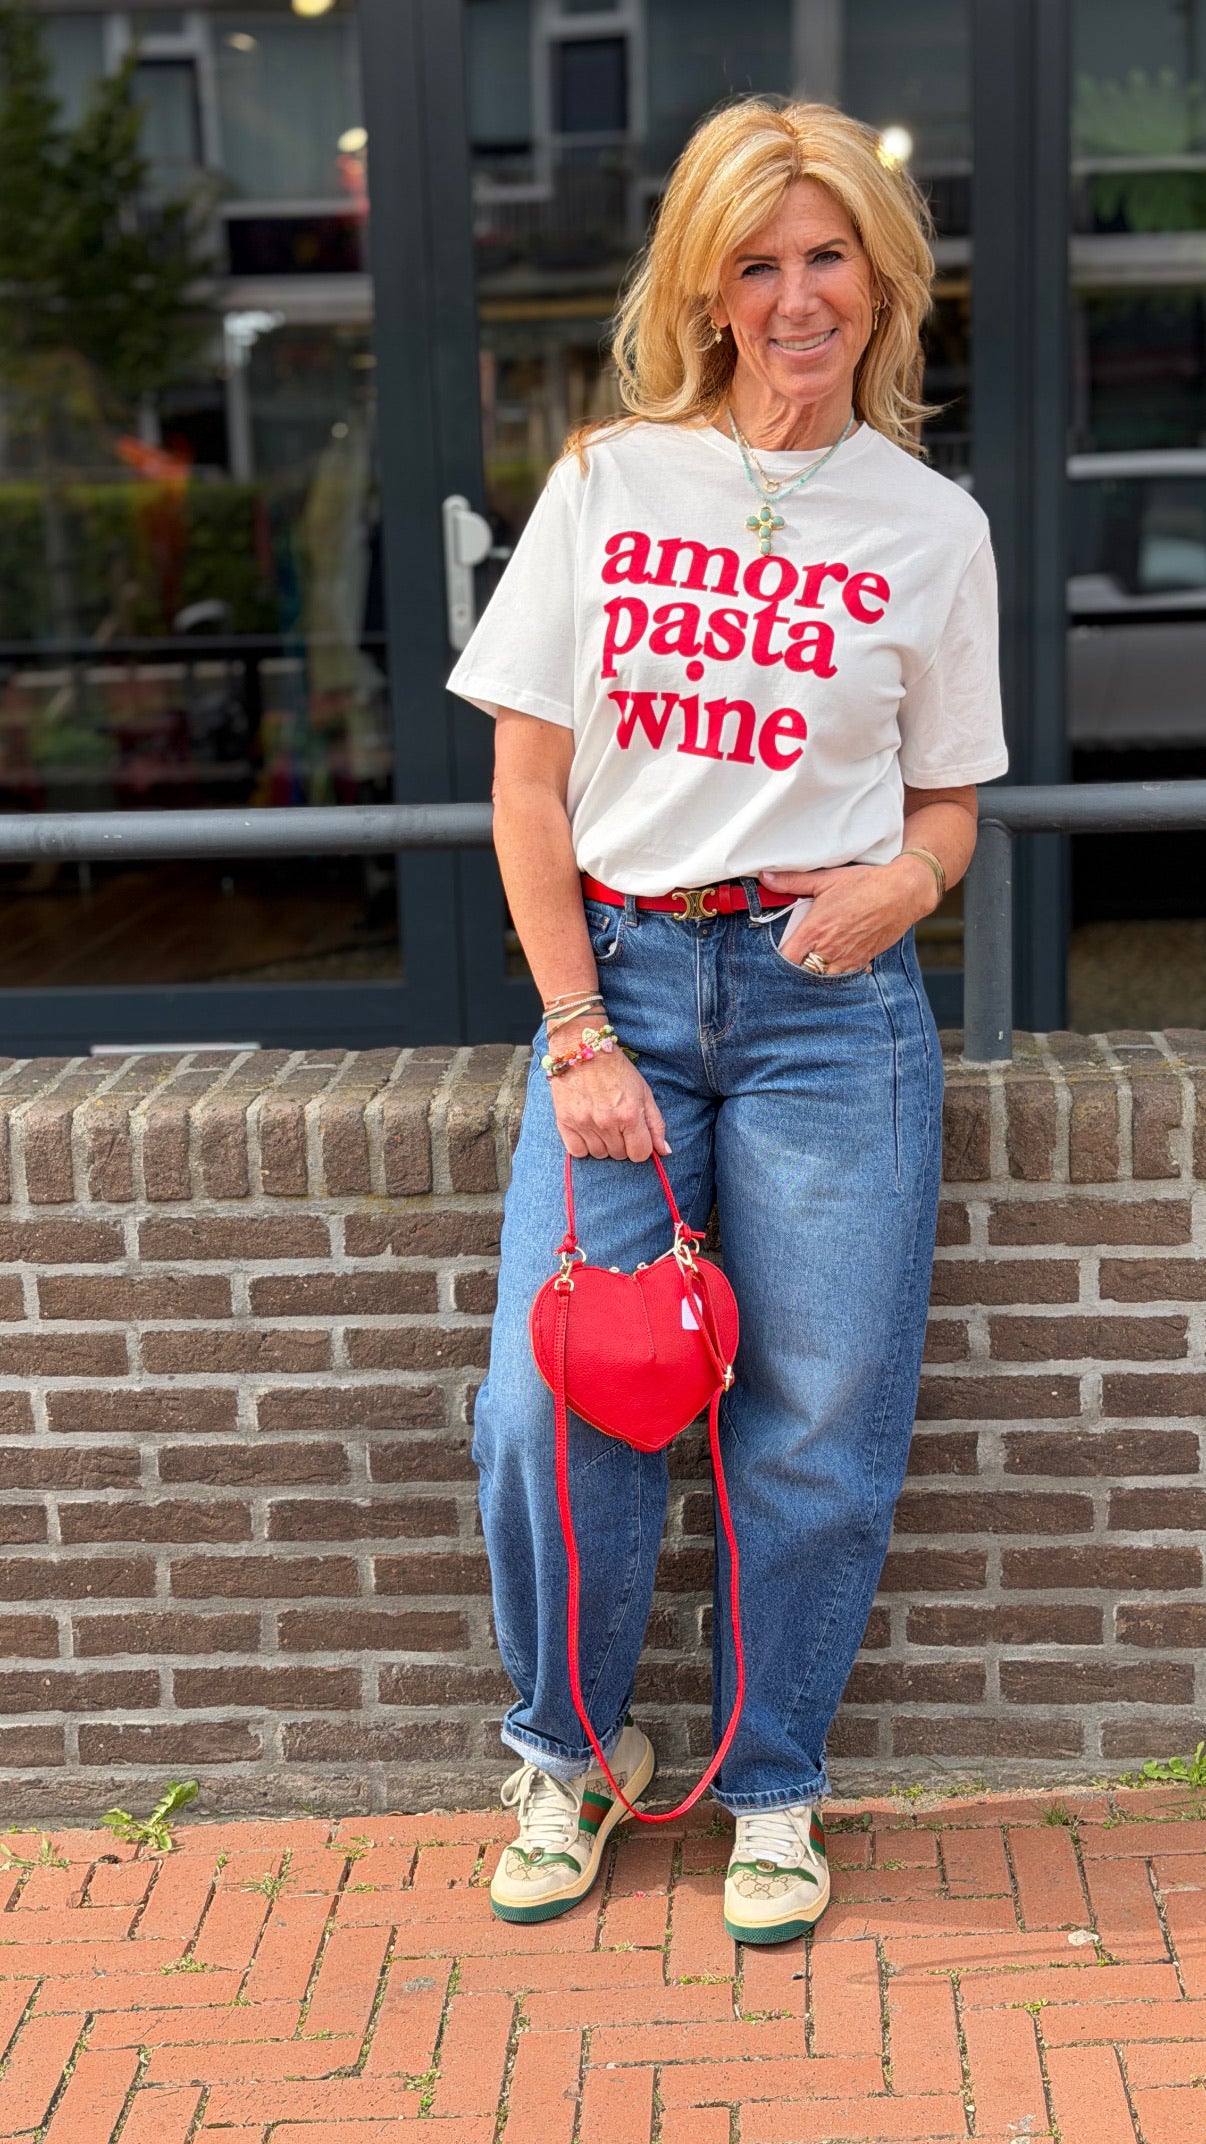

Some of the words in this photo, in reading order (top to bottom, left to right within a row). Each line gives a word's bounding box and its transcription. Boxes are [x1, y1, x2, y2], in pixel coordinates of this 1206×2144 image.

[601, 531, 891, 625] amore
[601, 595, 839, 680] pasta
[607, 660, 808, 772] wine
